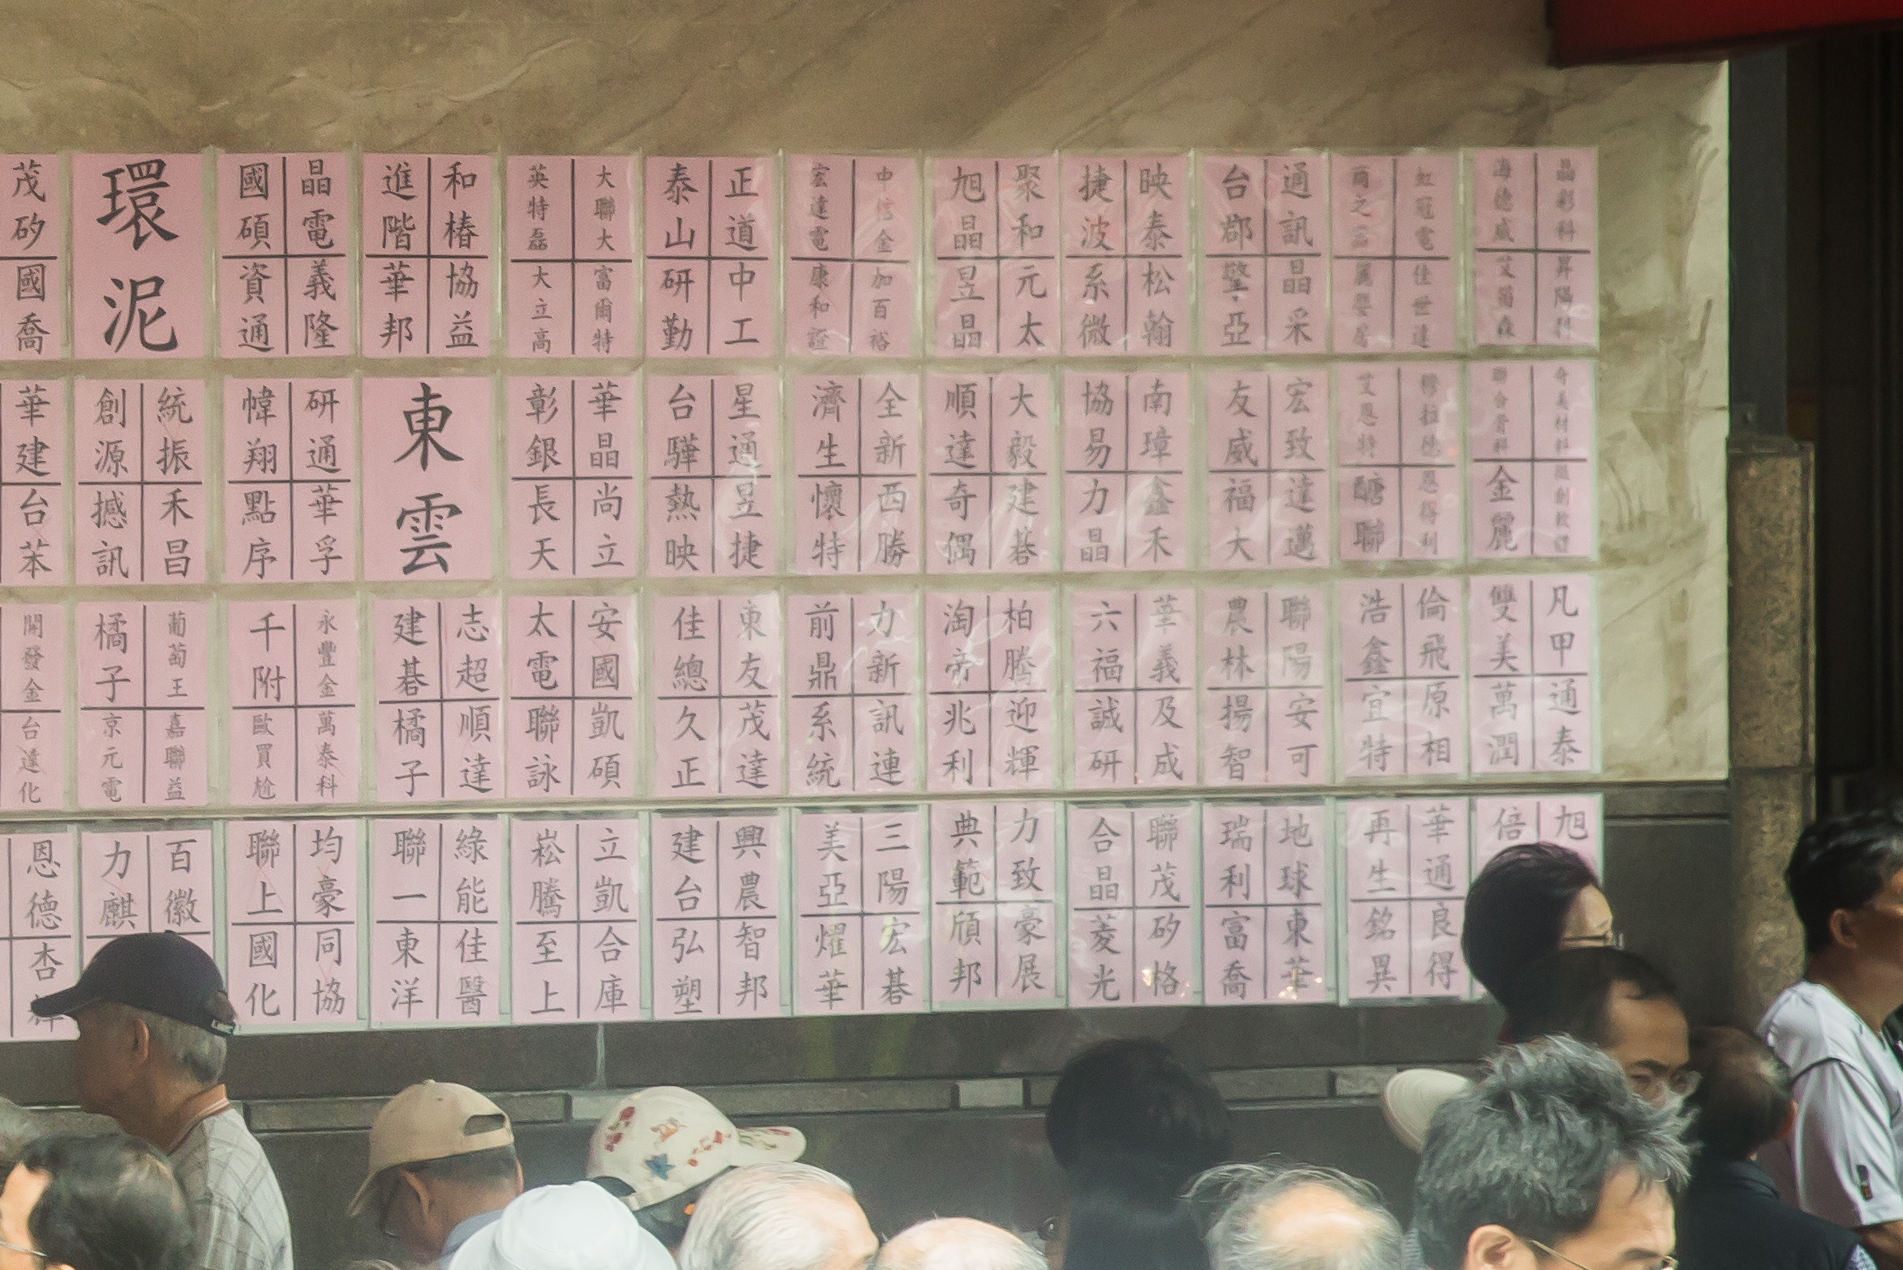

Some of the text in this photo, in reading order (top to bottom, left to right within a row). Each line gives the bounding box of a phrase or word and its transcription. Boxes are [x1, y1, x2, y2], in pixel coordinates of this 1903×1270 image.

[12, 159, 46, 249] 茂矽
[238, 162, 271, 249] 國碩
[301, 159, 334, 249] 晶電
[382, 161, 416, 251] 進階
[443, 161, 478, 249] 和椿
[528, 164, 549, 250] 英特磊
[664, 162, 698, 249] 泰山
[725, 166, 758, 251] 正道
[96, 158, 180, 352] 環泥
[16, 263, 50, 354] 國喬
[239, 262, 273, 352] 資通
[303, 259, 338, 349] 義隆
[445, 261, 479, 348] 協益
[532, 266, 552, 353] 大立高
[1017, 265, 1047, 345] 元太
[1142, 262, 1174, 347] 松翰
[16, 384, 50, 477] 華建
[95, 387, 128, 478] 創源
[305, 389, 341, 474] 研通
[526, 383, 561, 472] 彰銀
[874, 382, 906, 467] 全新
[1227, 381, 1258, 467] 友威
[394, 382, 464, 575] 東雲
[161, 488, 193, 577] 禾昌
[242, 490, 277, 579] 點序
[528, 484, 560, 570] 長天
[592, 482, 624, 568] 尚立
[665, 483, 700, 571] 熱映
[944, 479, 977, 566] 奇偶
[96, 613, 131, 703] 橘子
[250, 612, 286, 702] 千附
[588, 602, 622, 690] 安國
[1362, 589, 1391, 675] 浩鑫
[1548, 585, 1578, 666] 凡甲
[102, 713, 122, 802] 京元電
[589, 702, 624, 788] 凱碩
[672, 705, 705, 788] 久正
[870, 699, 904, 786] 訊連
[943, 700, 976, 785] 兆利
[1154, 696, 1183, 780] 及成
[392, 828, 426, 900] 聯一
[454, 826, 488, 914] 綠能
[672, 825, 704, 912] 建台
[876, 823, 909, 905] 三陽
[1011, 808, 1043, 891] 力致
[1090, 817, 1121, 900] 合晶
[1220, 815, 1252, 900] 瑞利
[1278, 818, 1312, 900] 地球
[246, 931, 280, 1016] 國化
[392, 927, 423, 1018] 東洋
[595, 926, 629, 1013] 合庫
